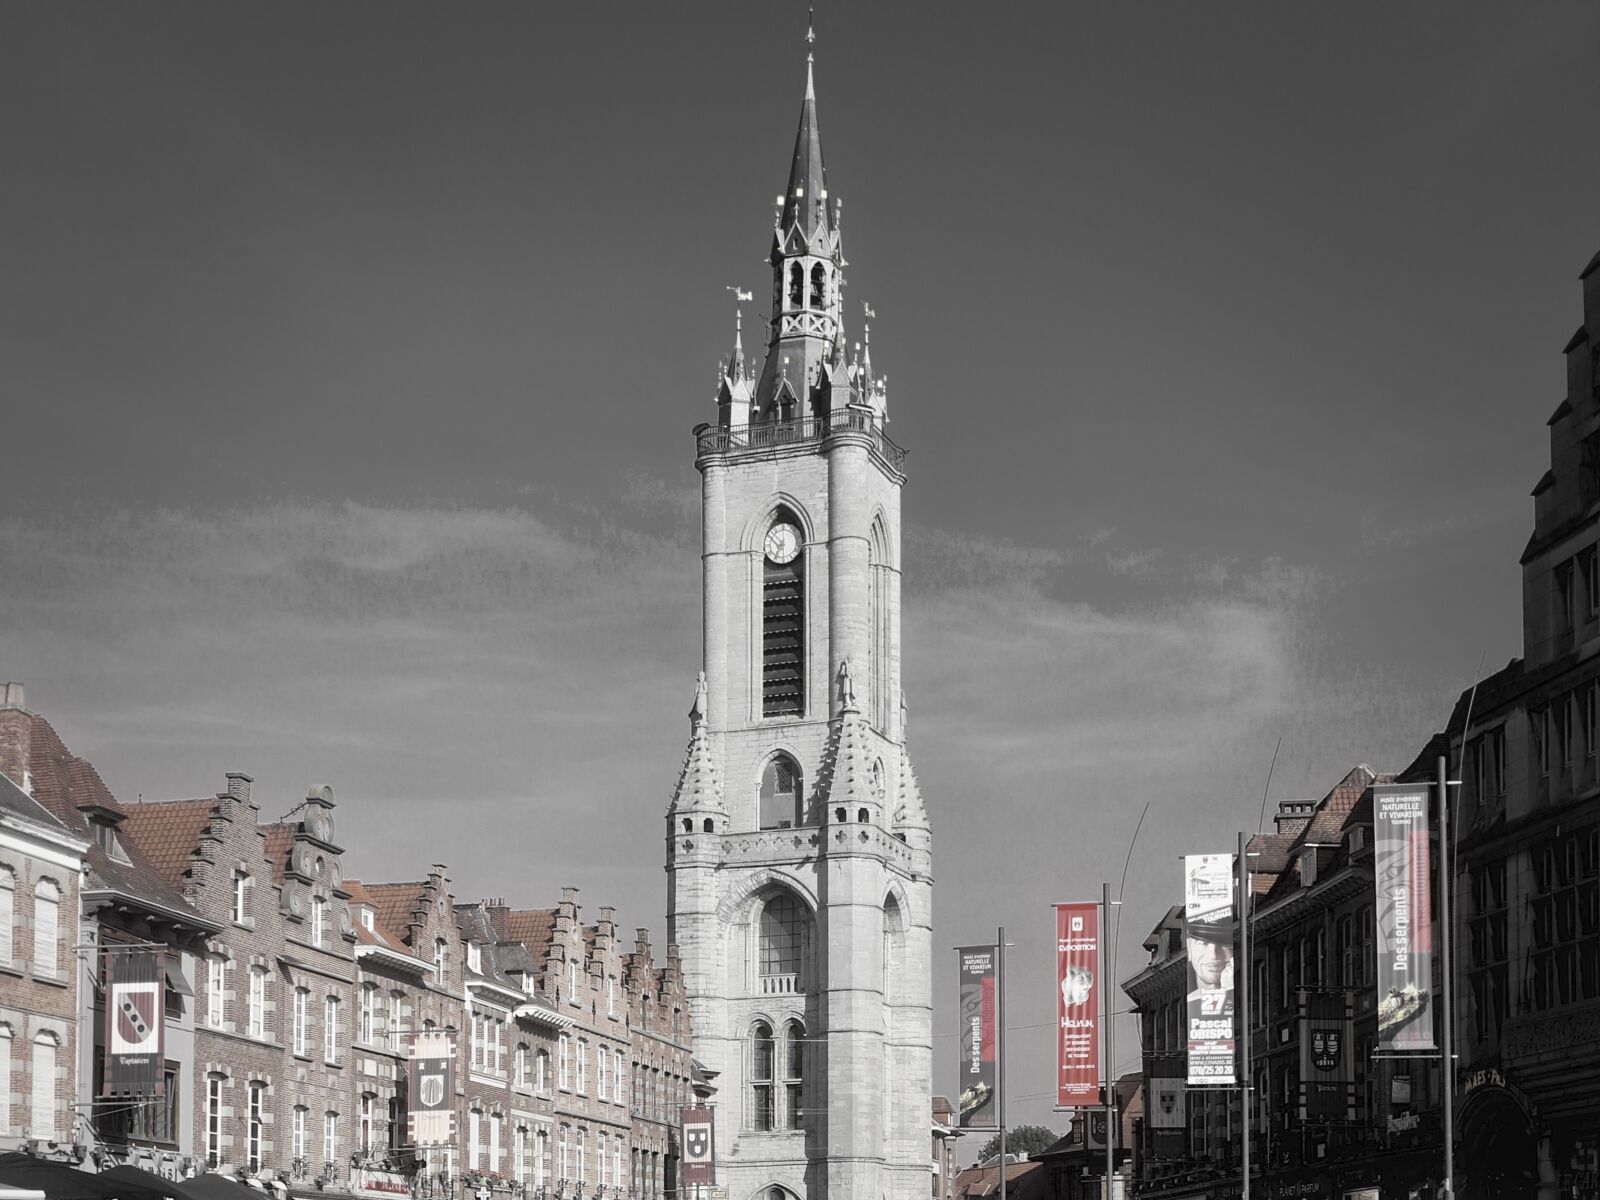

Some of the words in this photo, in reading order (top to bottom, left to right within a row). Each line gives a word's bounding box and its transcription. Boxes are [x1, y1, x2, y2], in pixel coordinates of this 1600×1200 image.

[1379, 812, 1388, 820] ET
[1389, 810, 1423, 819] VIVARIUM
[1382, 803, 1420, 811] NATURELLE
[1392, 888, 1410, 949] serpents
[1393, 950, 1408, 970] Des
[1201, 994, 1226, 1011] 27
[1191, 1017, 1233, 1029] Pascal
[971, 1016, 982, 1055] serpents
[1190, 1028, 1233, 1040] OBISPO
[970, 1057, 980, 1074] Des
[1214, 1065, 1224, 1075] 20
[1224, 1065, 1233, 1075] 20
[1464, 1070, 1487, 1095] MAES
[1280, 1185, 1297, 1197] PLANET
[1302, 1182, 1320, 1193] PARFUM
